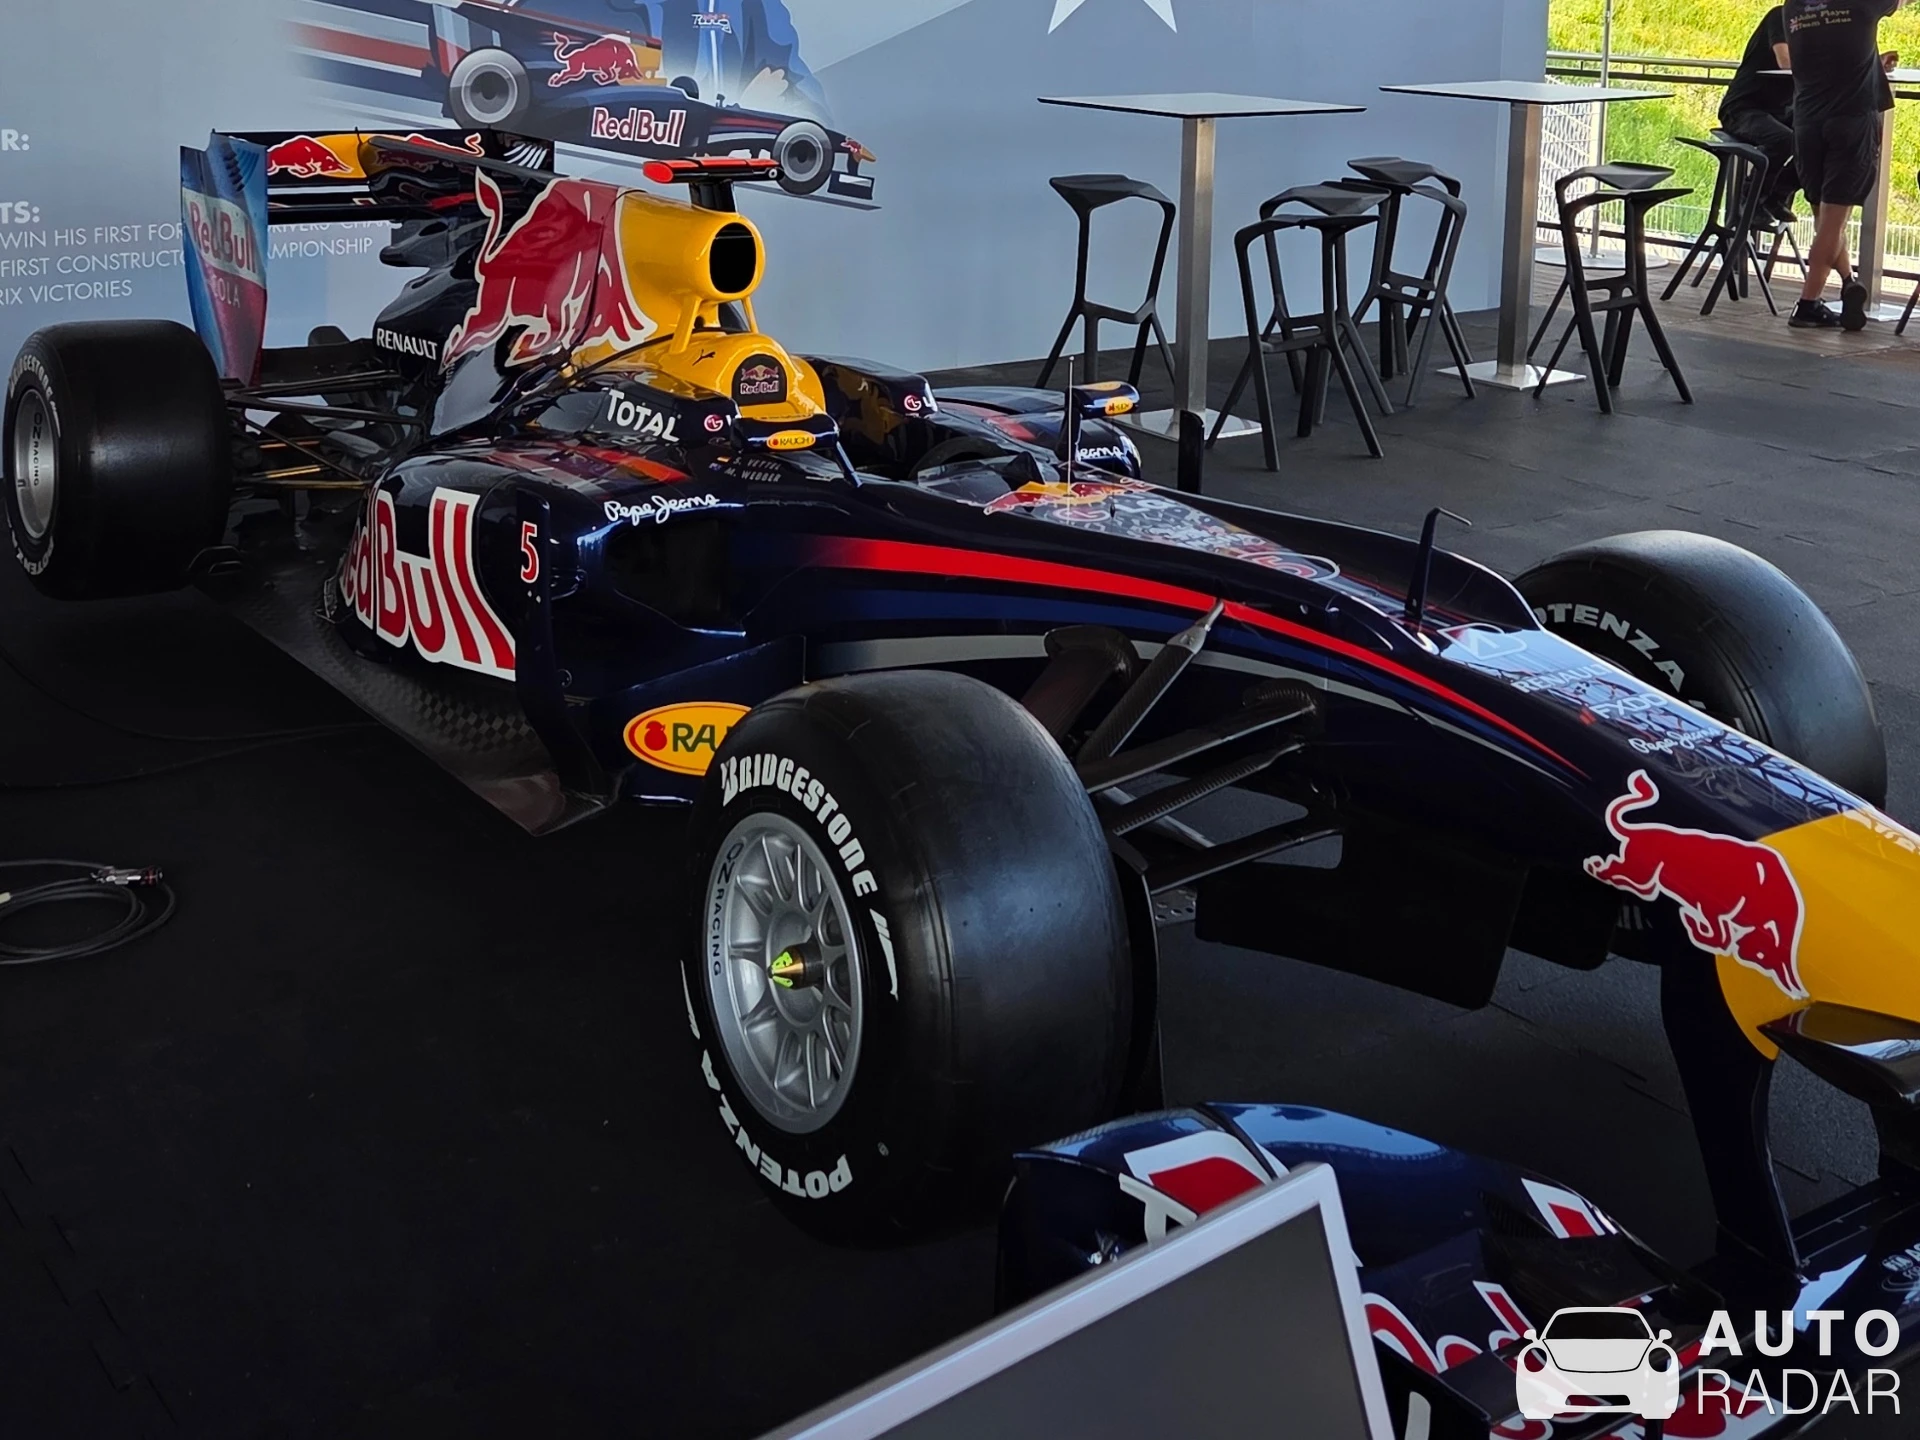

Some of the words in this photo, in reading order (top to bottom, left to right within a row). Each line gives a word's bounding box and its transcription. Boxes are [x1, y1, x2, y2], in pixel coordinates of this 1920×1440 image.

[591, 106, 637, 141] Red
[634, 109, 687, 147] Bull
[0, 230, 47, 250] WIN
[54, 228, 87, 246] HIS
[94, 225, 142, 244] FIRST
[267, 237, 373, 260] MPIONSHIP
[1, 257, 50, 278] FIRST
[29, 279, 133, 303] VICTORIES
[375, 327, 438, 361] RENAULT
[740, 380, 761, 395] Red
[761, 380, 780, 394] Bull
[607, 388, 679, 442] TOTAL
[741, 470, 782, 483] WEBBER
[747, 458, 782, 471] VETTEL
[604, 501, 655, 526] Pepe
[651, 494, 720, 524] Jeans
[521, 520, 539, 584] 5
[376, 486, 516, 682] Bull
[720, 753, 878, 898] BRIDGESTONE
[712, 888, 725, 977] RACING
[701, 1049, 854, 1200] POTENZA
